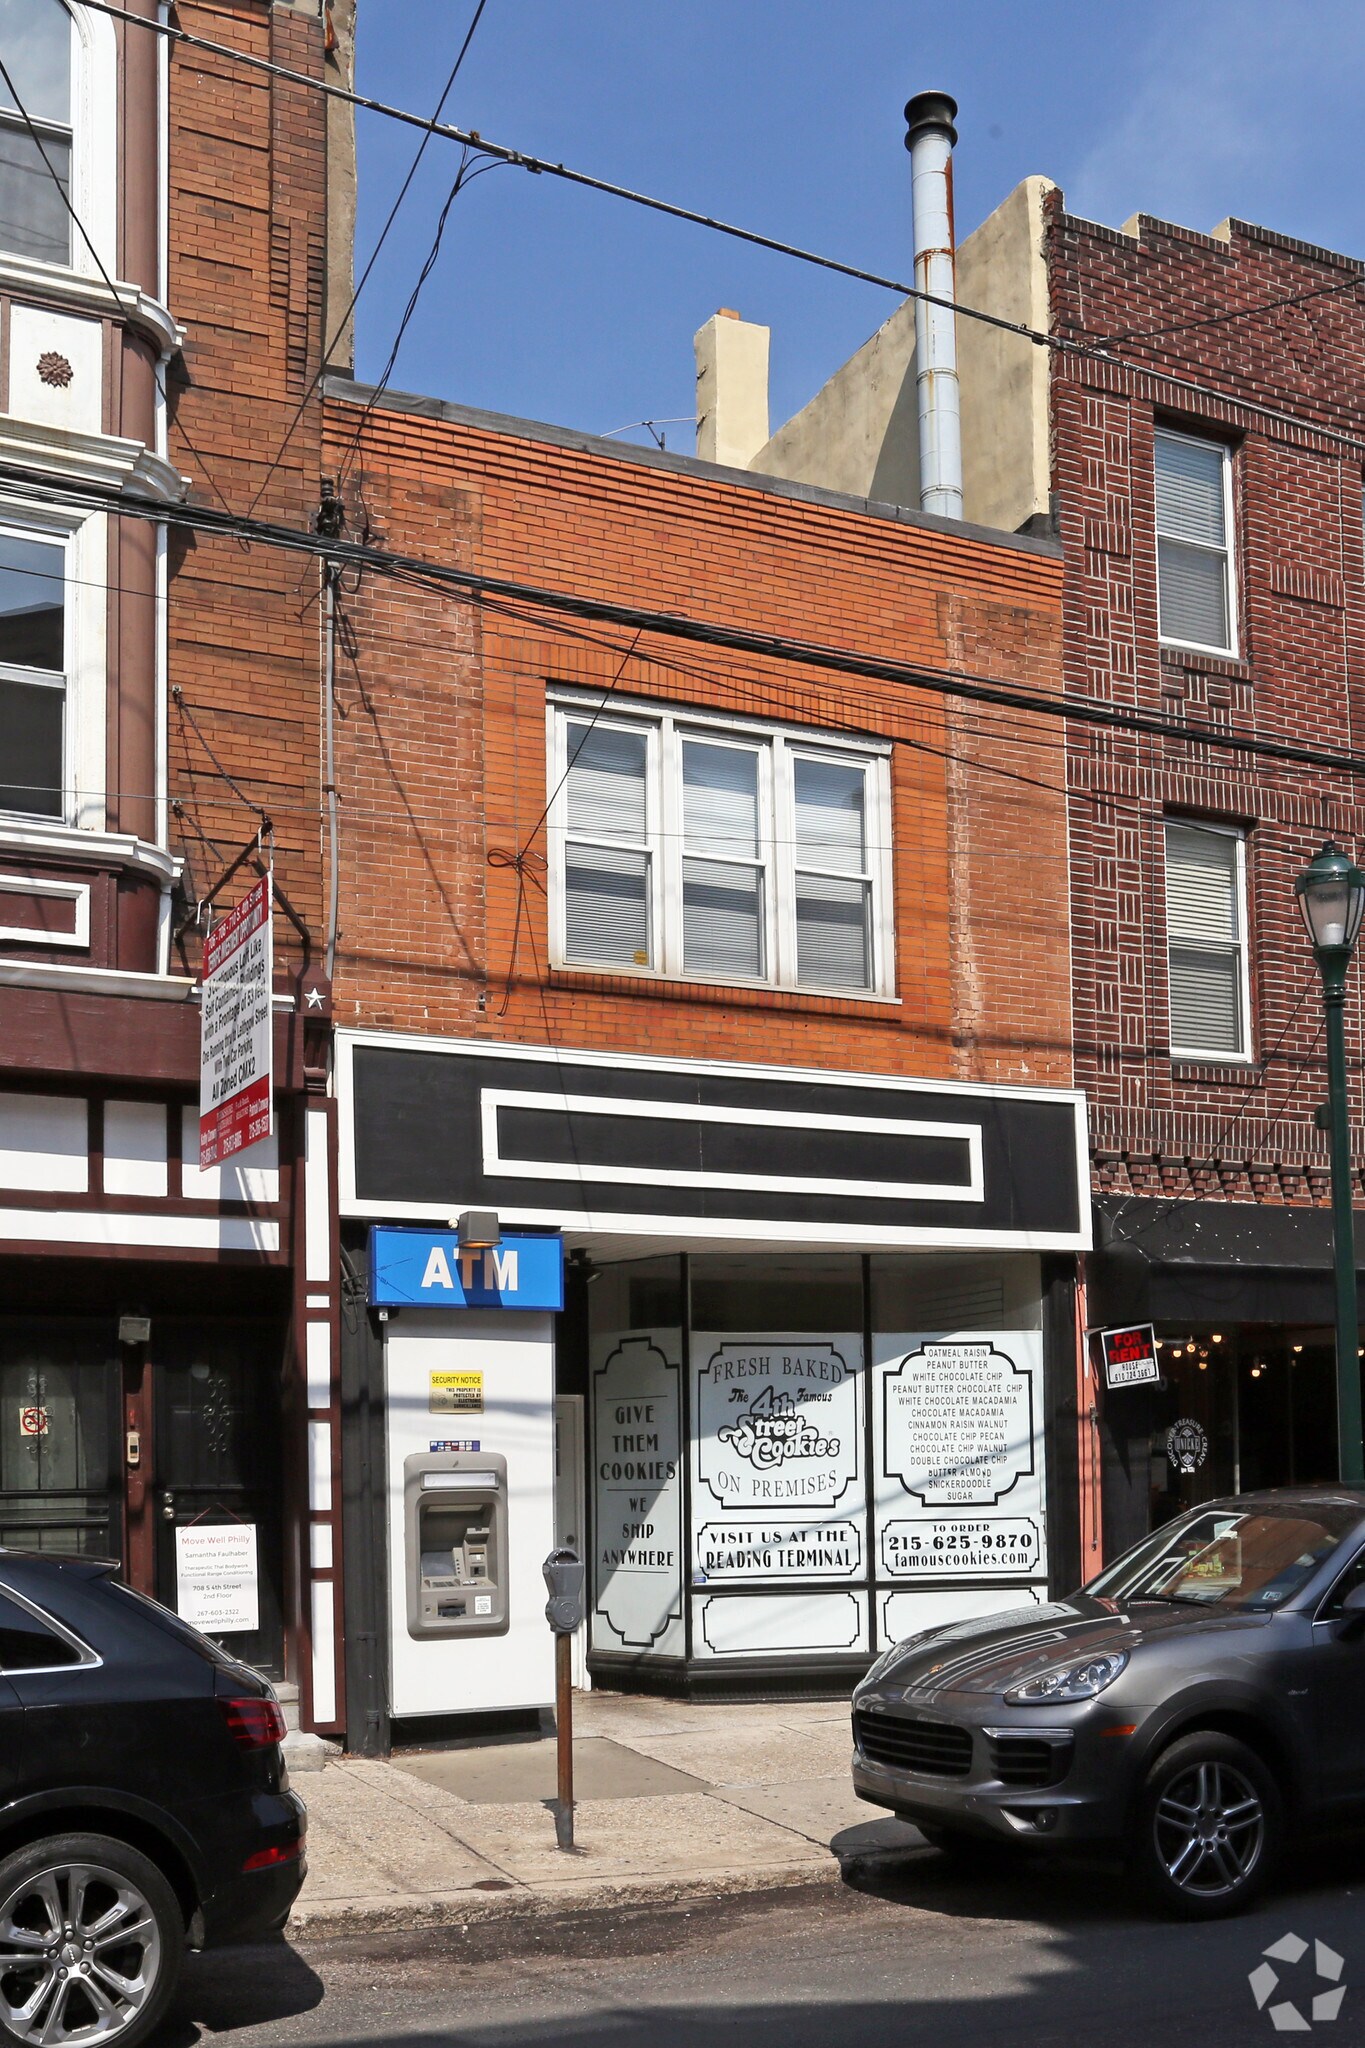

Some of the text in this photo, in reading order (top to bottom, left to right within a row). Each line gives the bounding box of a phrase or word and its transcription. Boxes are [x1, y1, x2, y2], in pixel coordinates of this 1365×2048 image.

[250, 884, 263, 908] Street
[240, 947, 250, 970] Loft
[250, 939, 262, 959] Like
[205, 1001, 214, 1020] Self
[240, 959, 264, 984] Buildings
[204, 1021, 214, 1041] with
[215, 1022, 218, 1033] a
[219, 1002, 240, 1029] Frontage
[242, 995, 246, 1013] of
[247, 990, 254, 1007] 53
[210, 1038, 224, 1061] Running
[255, 1003, 268, 1025] Street
[238, 1037, 253, 1058] Parking
[220, 1068, 237, 1095] Zoned
[238, 1057, 255, 1083] CMX2
[421, 1246, 519, 1291] ATM
[1114, 1331, 1142, 1348] FOR
[928, 1348, 987, 1358] OATMEAL RAISIN
[1108, 1344, 1151, 1363] RENT
[713, 1356, 843, 1384] FRESH BAKED
[926, 1360, 988, 1370] PEANUT BUTTER
[1122, 1362, 1138, 1371] HOUSE
[913, 1372, 1003, 1382] WHITE CHOCOLATE CHIP
[893, 1384, 1023, 1393] PEANUT BUTTER CHOCOLATE CHIP
[728, 1385, 833, 1418] The 4th Famous
[898, 1396, 1017, 1405] WHITE CHOCOLATE MACADAMIA
[615, 1406, 655, 1424] GIVE
[911, 1408, 1004, 1418] CHOCOLATE MACADAMIA
[908, 1420, 1008, 1430] CINNAMON RAISIN WALNUT
[1174, 1418, 1204, 1434] TREASURE
[612, 1434, 659, 1453] THEM
[718, 1414, 806, 1457] Street
[913, 1432, 1005, 1441] CHOCOLATE CHIP PECAN
[751, 1435, 840, 1470] Cookies
[909, 1443, 1008, 1453] CHOCOLATE CHIP WALNUT
[1167, 1427, 1178, 1467] DISCOVER
[1197, 1436, 1208, 1466] CREATE
[910, 1456, 1008, 1466] DOUBLE CHOCOLATE CHIP
[600, 1461, 676, 1481] COOKIES
[718, 1470, 837, 1497] ON PREMISES
[928, 1479, 991, 1489] SNICKERDOODLE
[629, 1497, 647, 1512] WE
[947, 1491, 973, 1501] SUGAR
[622, 1524, 655, 1539] SHIP
[710, 1530, 848, 1544] VISIT US AT THE
[933, 1524, 990, 1533] TO ORDER
[228, 1536, 250, 1545] Philly
[889, 1533, 1032, 1551] 215-625-9870
[602, 1550, 674, 1567] ANYWHERE
[706, 1548, 852, 1569] READING TERMINAL
[894, 1549, 1028, 1568] famouscookies.com
[197, 1609, 239, 1617] 267-603-2322
